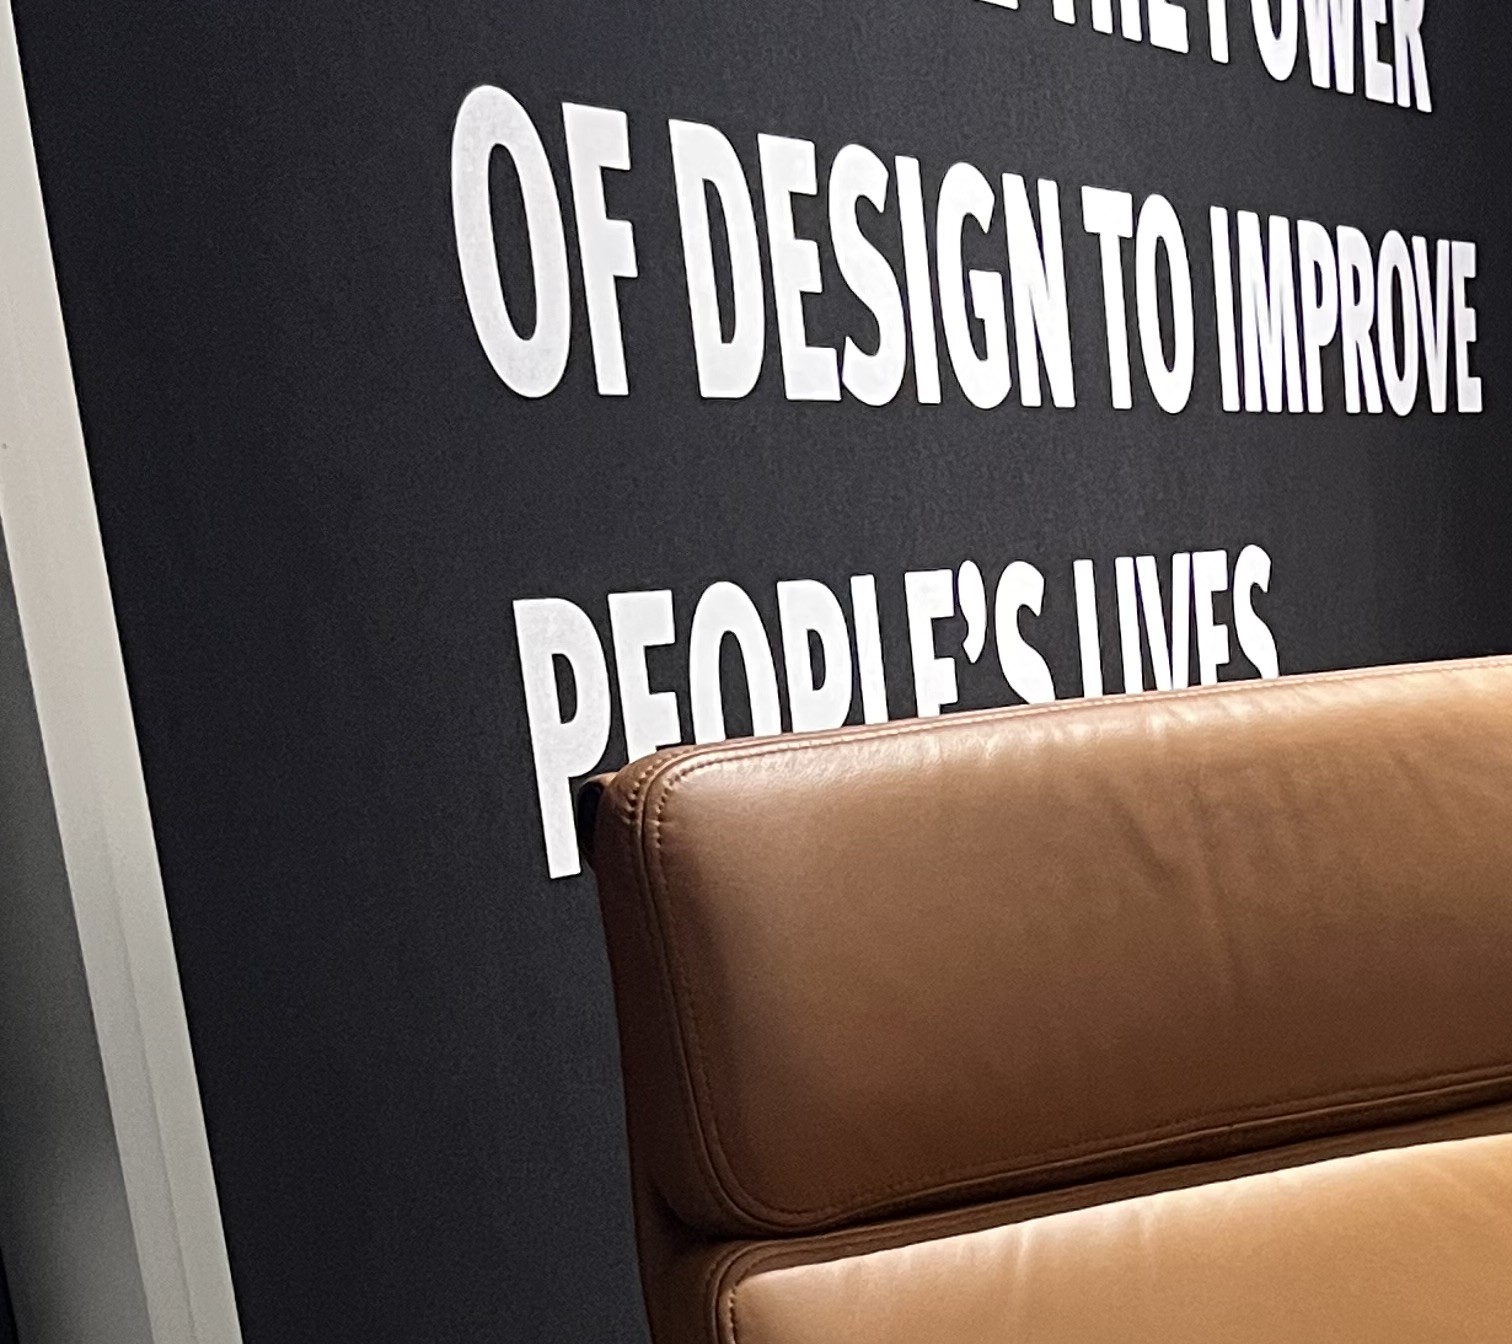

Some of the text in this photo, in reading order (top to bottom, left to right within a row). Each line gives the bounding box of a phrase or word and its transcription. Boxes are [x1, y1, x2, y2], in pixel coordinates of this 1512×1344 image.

[450, 84, 1483, 416] OF DESIGN TO IMPROVE
